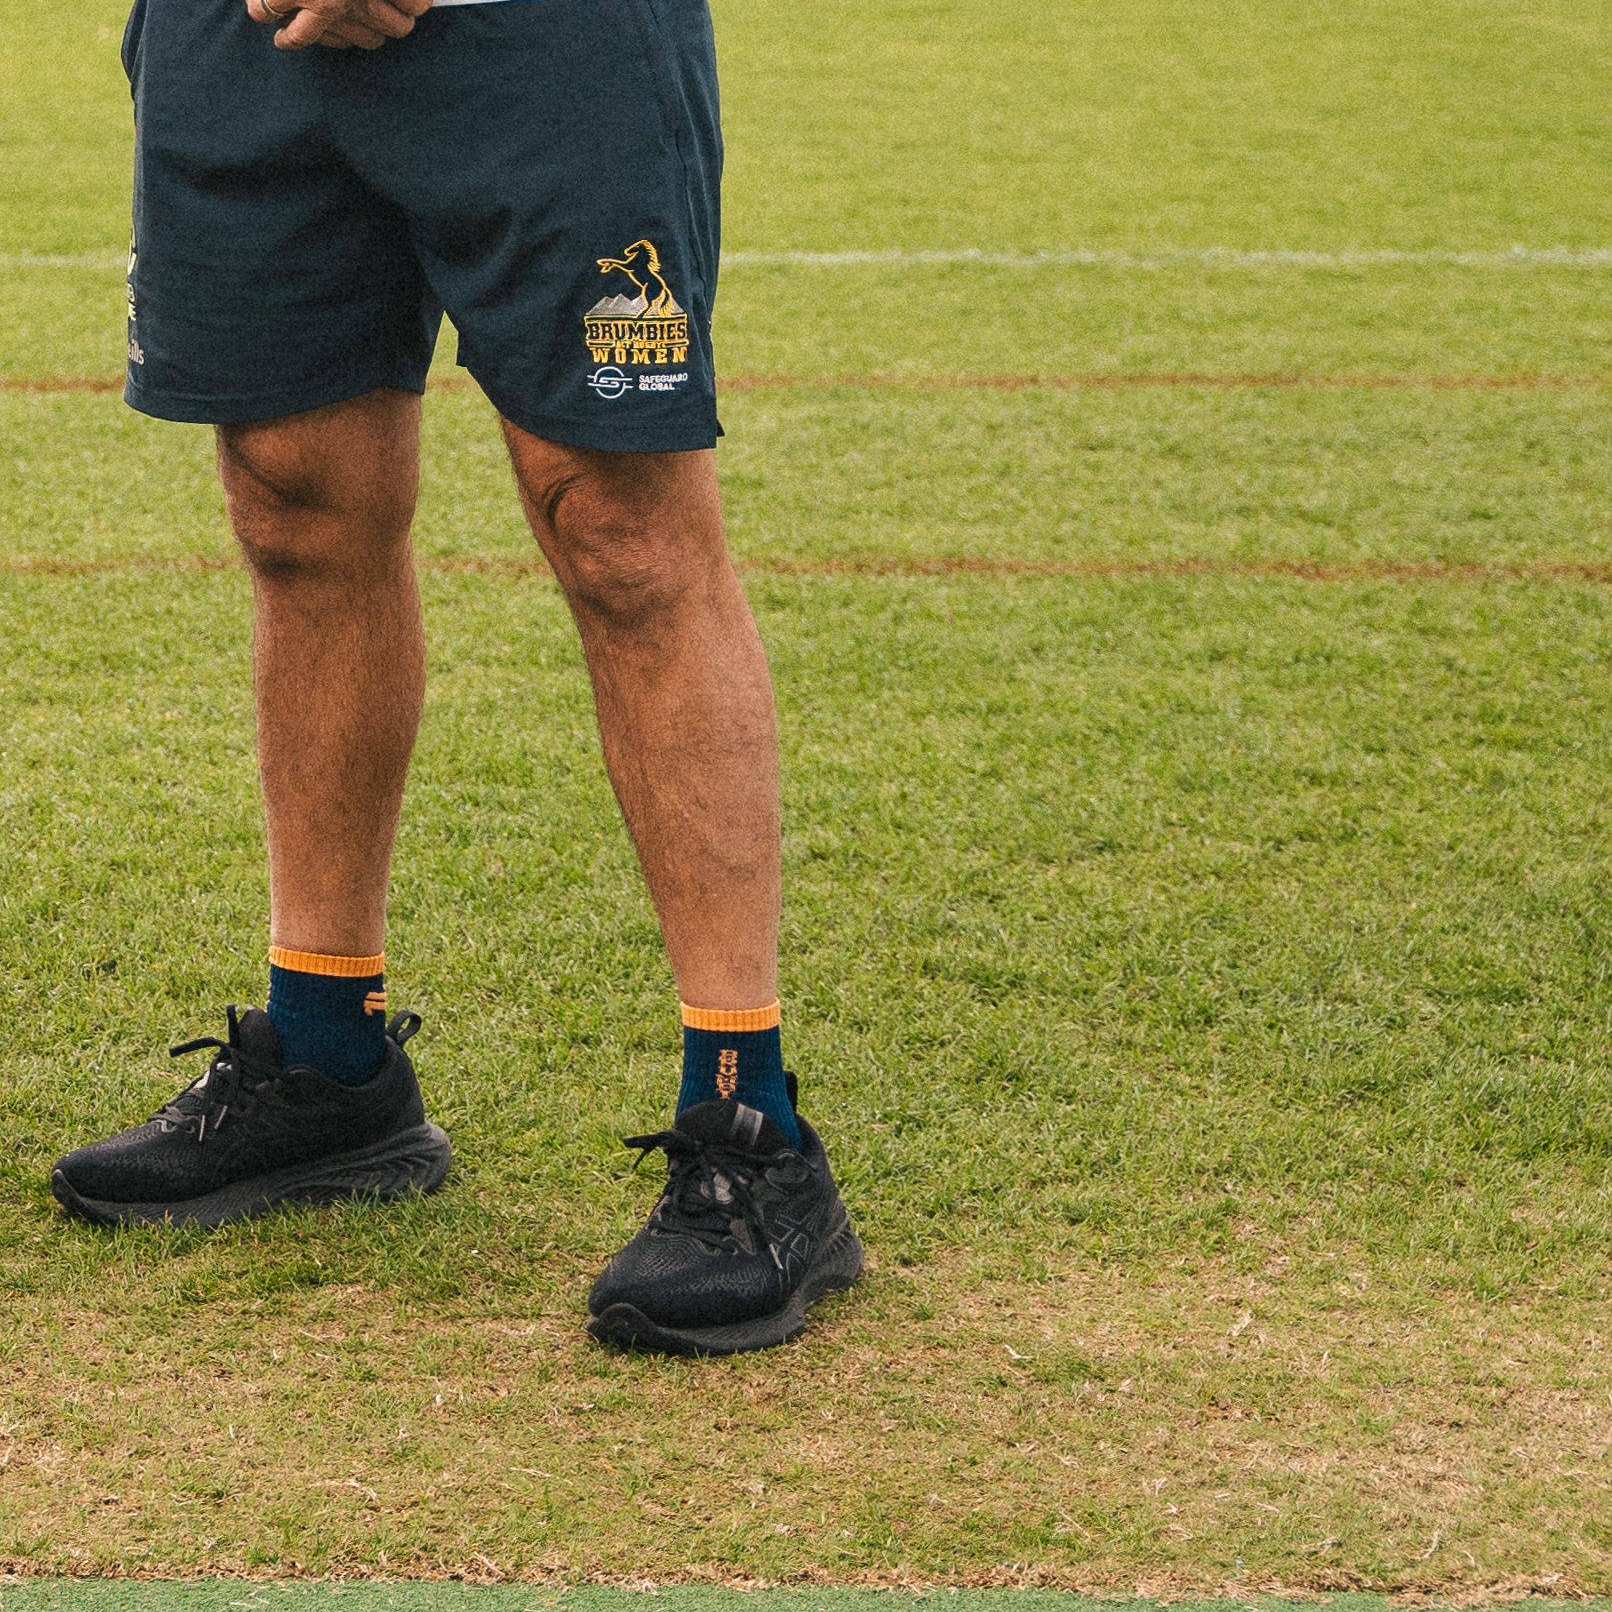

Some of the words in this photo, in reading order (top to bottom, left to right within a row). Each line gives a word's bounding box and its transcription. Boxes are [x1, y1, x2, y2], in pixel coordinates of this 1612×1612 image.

[587, 322, 687, 340] BRUMBIES
[589, 347, 687, 365] WOMEN
[639, 373, 688, 383] SAFEGUARD
[639, 382, 675, 391] GLOBAL
